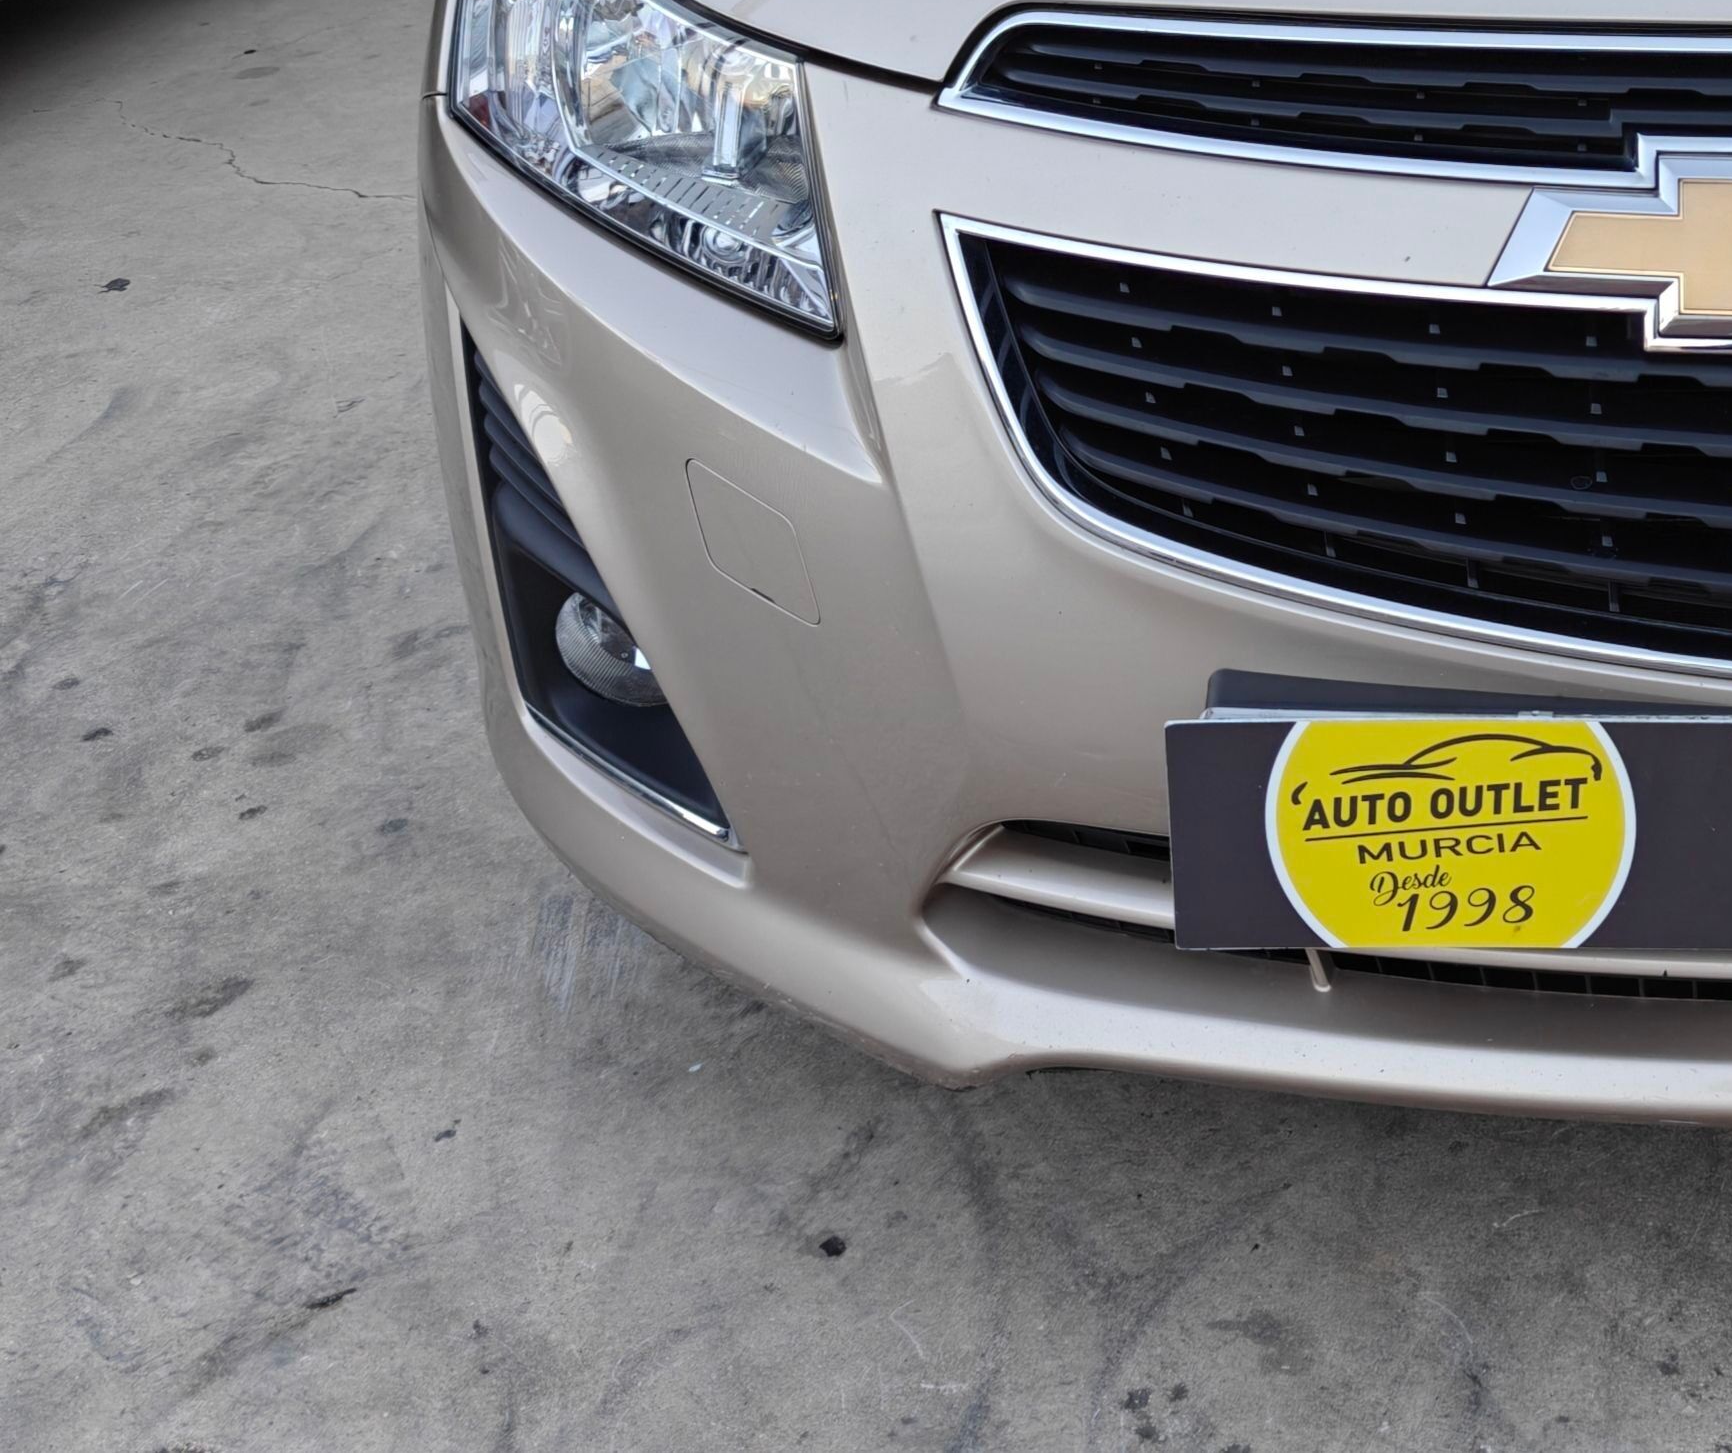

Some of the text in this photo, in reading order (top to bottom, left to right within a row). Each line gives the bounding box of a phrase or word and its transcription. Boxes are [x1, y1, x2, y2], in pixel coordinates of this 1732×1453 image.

[1302, 778, 1588, 831] AUTO OUTLET
[1358, 832, 1541, 863] MURCIA
[1369, 864, 1452, 906] Desde
[1397, 885, 1536, 932] 1998
